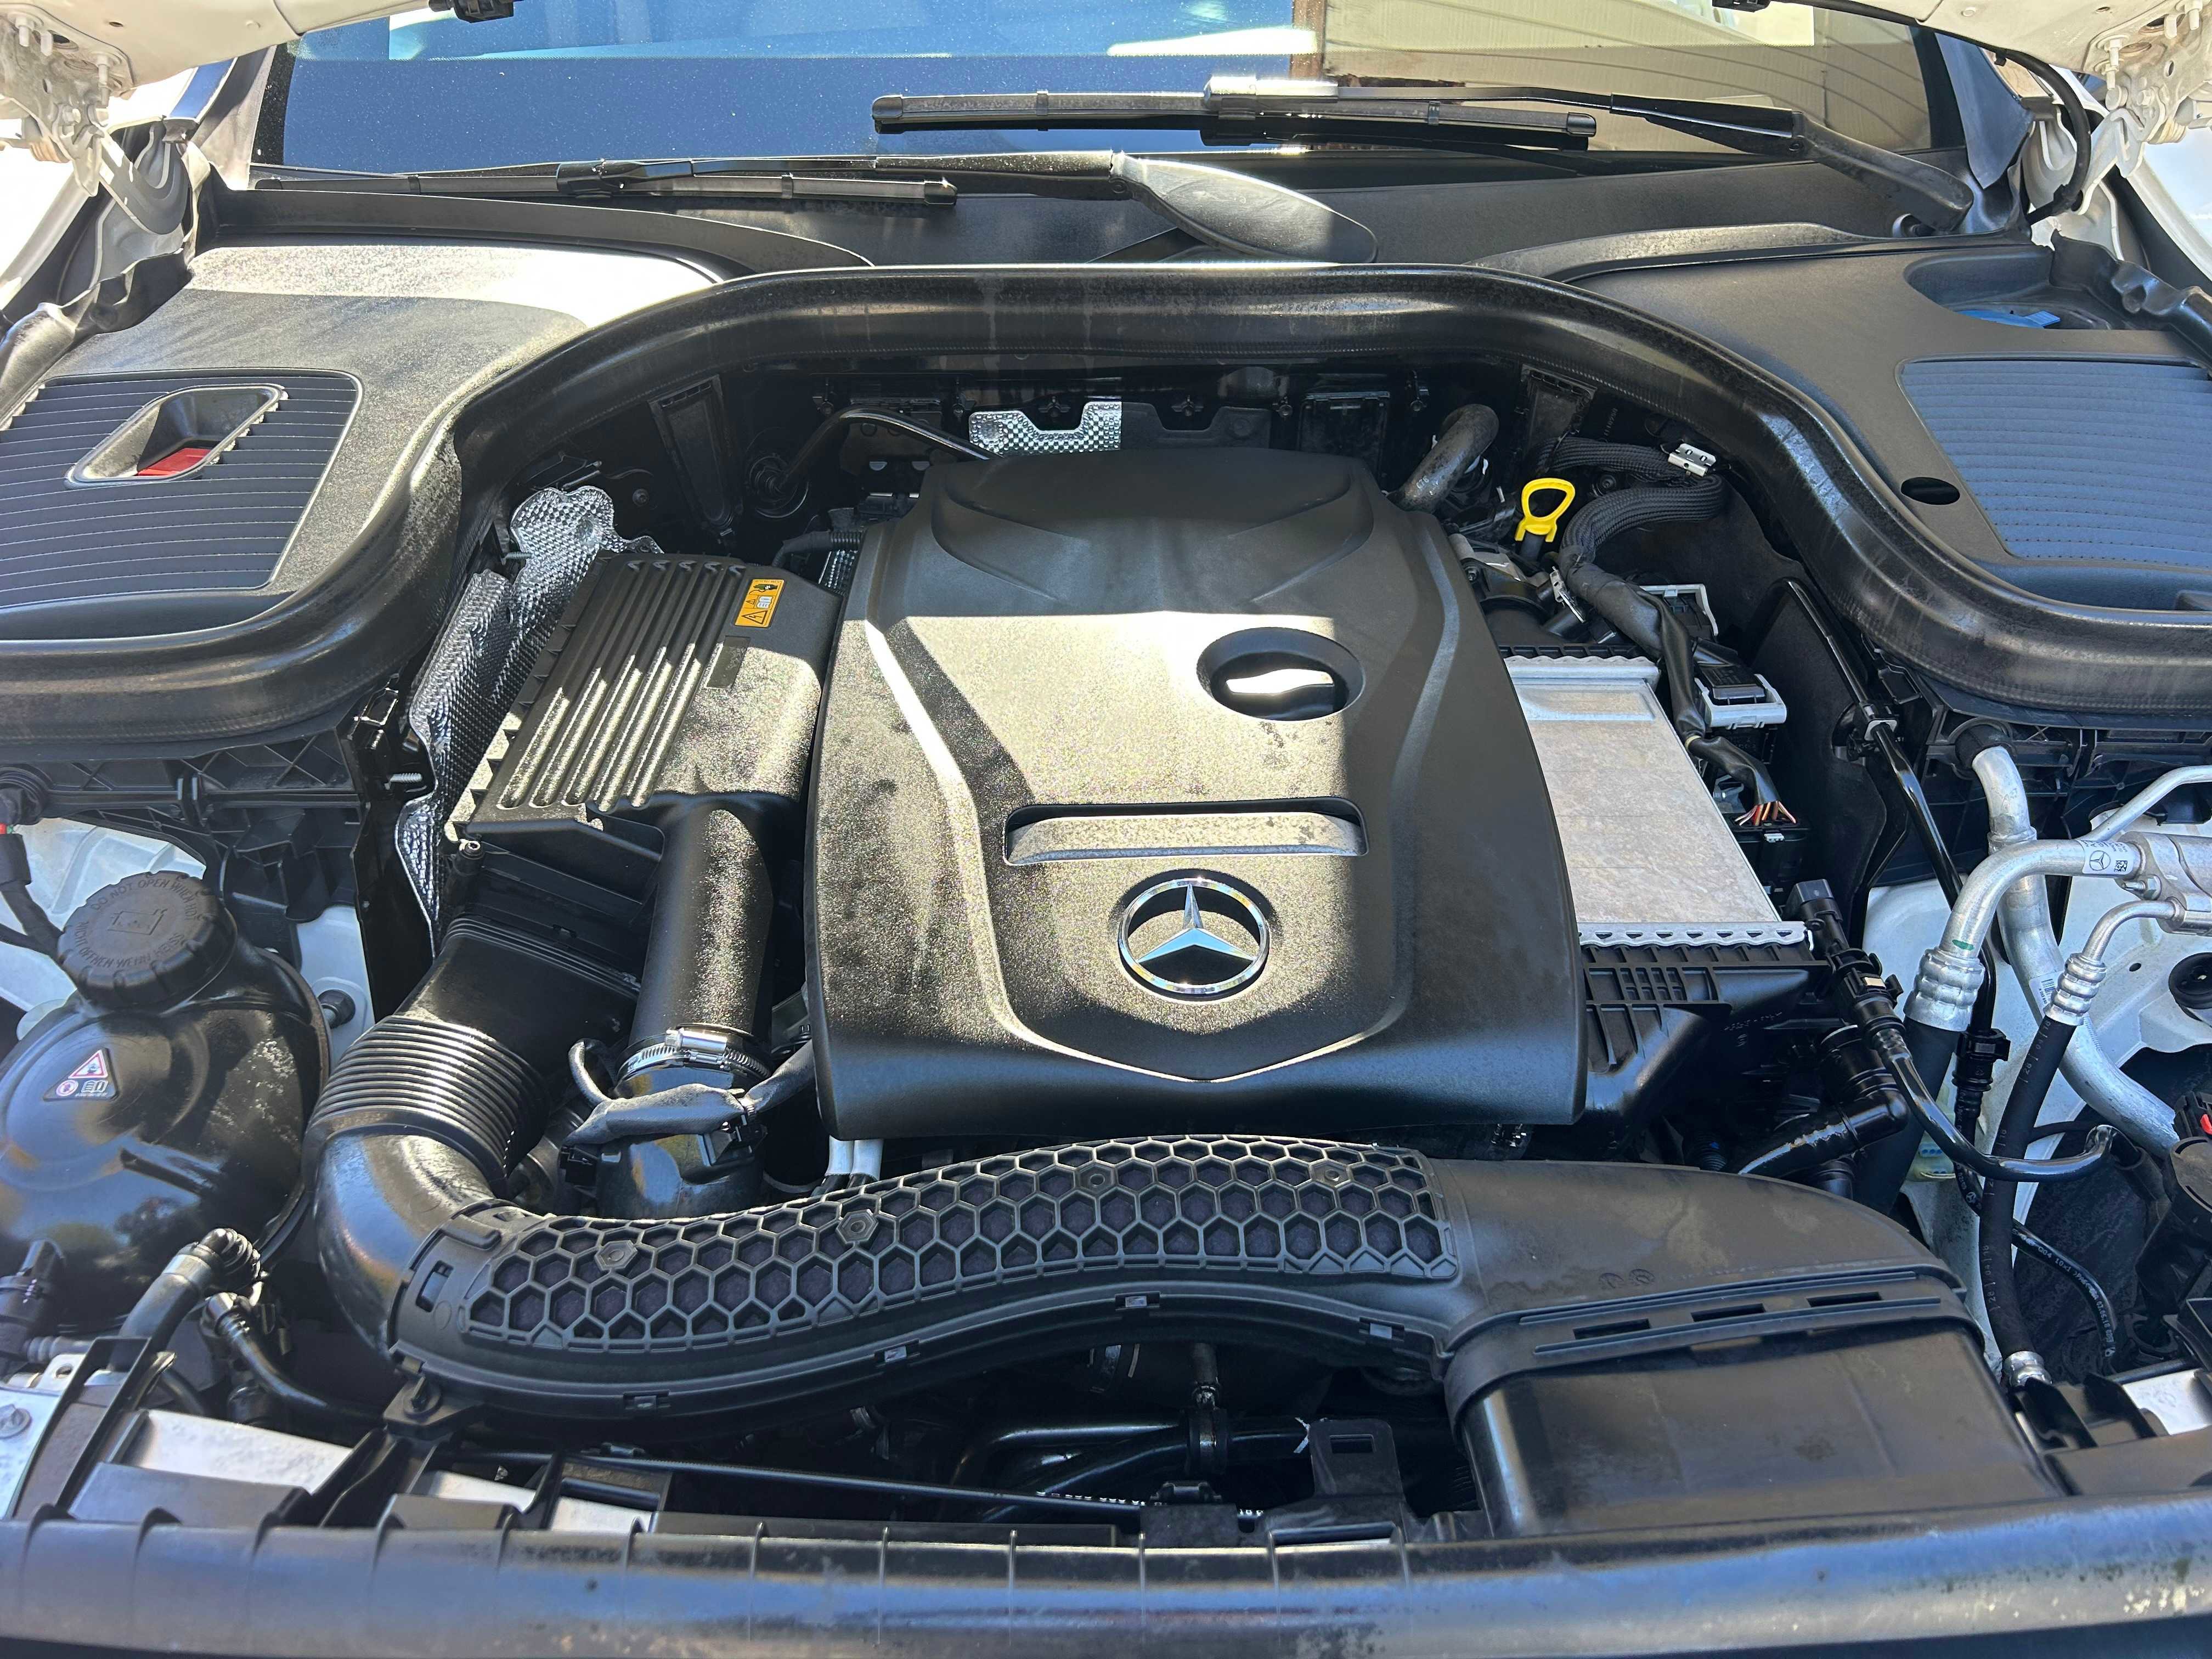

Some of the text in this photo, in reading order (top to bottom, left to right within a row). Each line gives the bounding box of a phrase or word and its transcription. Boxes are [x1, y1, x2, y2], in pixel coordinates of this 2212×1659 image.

[90, 896, 109, 911] DO
[110, 883, 133, 899] NOT
[138, 879, 170, 888] OPEN
[171, 880, 195, 904] WHEN
